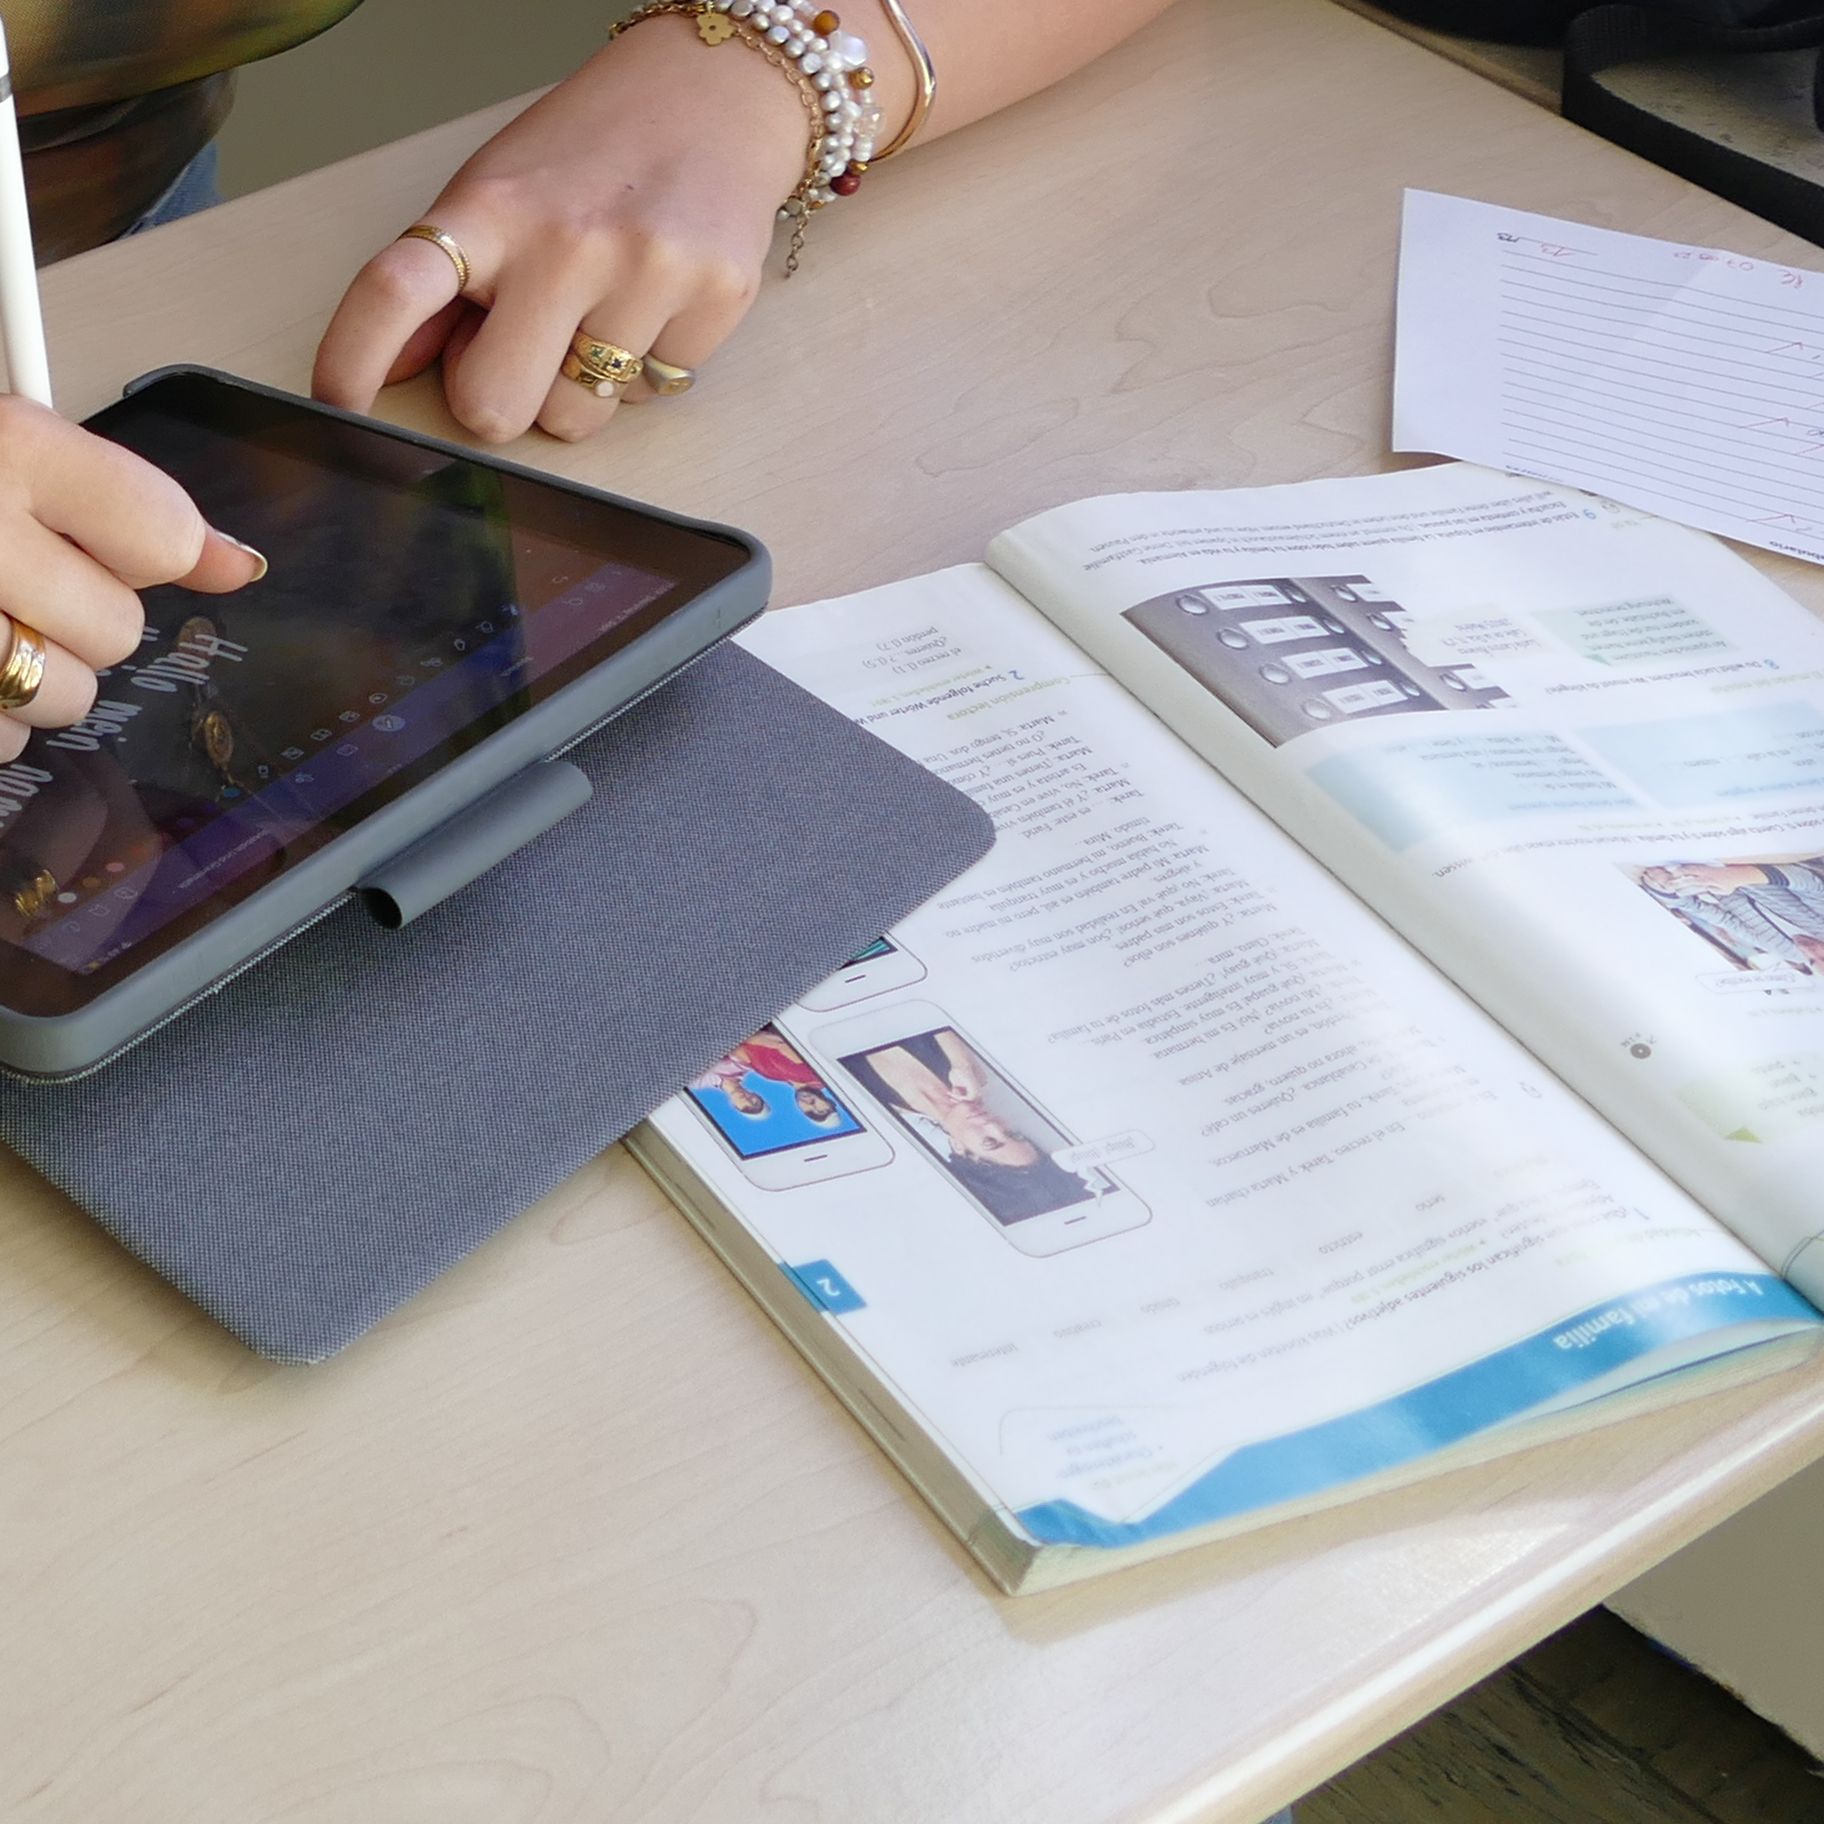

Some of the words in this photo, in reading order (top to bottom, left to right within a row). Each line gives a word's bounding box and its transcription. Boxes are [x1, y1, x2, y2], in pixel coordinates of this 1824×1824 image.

[972, 674, 1006, 688] Suche
[1008, 669, 1024, 680] 2
[927, 686, 973, 704] folgende
[990, 677, 1070, 704] Comprensión
[866, 712, 887, 723] und
[890, 702, 927, 715] Wörter
[947, 701, 991, 720] lectora
[45, 700, 143, 752] mein
[815, 1274, 842, 1298] 2
[1554, 1310, 1633, 1349] familia
